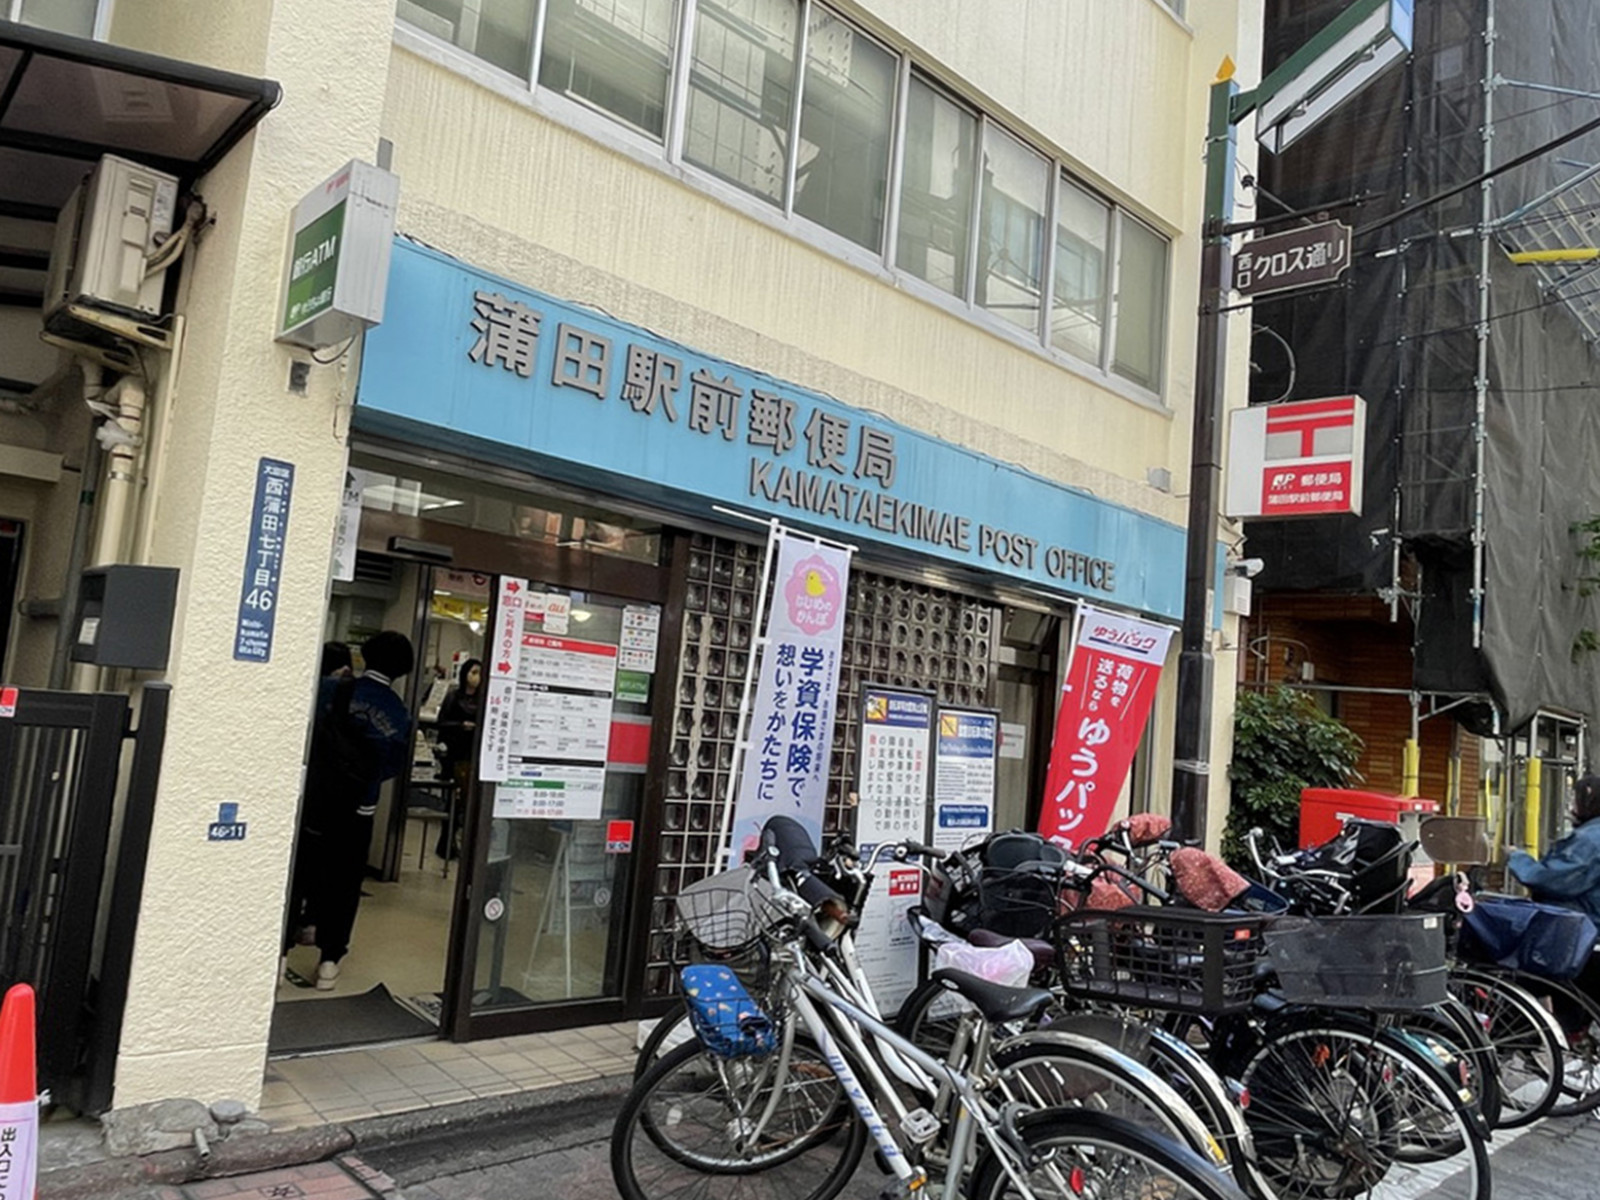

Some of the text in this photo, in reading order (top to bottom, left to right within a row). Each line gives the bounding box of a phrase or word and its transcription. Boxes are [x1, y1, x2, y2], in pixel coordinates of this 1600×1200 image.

[1237, 252, 1253, 289] 西口
[1254, 239, 1345, 280] クロス通り
[467, 290, 898, 489] 蒲田駅前郵便局
[1301, 472, 1342, 487] 郵便局
[254, 476, 284, 587] 西蒲田七丁目
[750, 458, 1115, 592] KAMATAEKIMAE POST OFFICE
[245, 588, 273, 611] 46
[1093, 625, 1158, 650] ゆうパック
[1088, 657, 1115, 712] 送るなら
[1110, 662, 1135, 708] 荷物を
[757, 642, 797, 801] 想いをかたちに
[786, 646, 825, 808] 学資保険で、
[211, 825, 243, 838] 46-11
